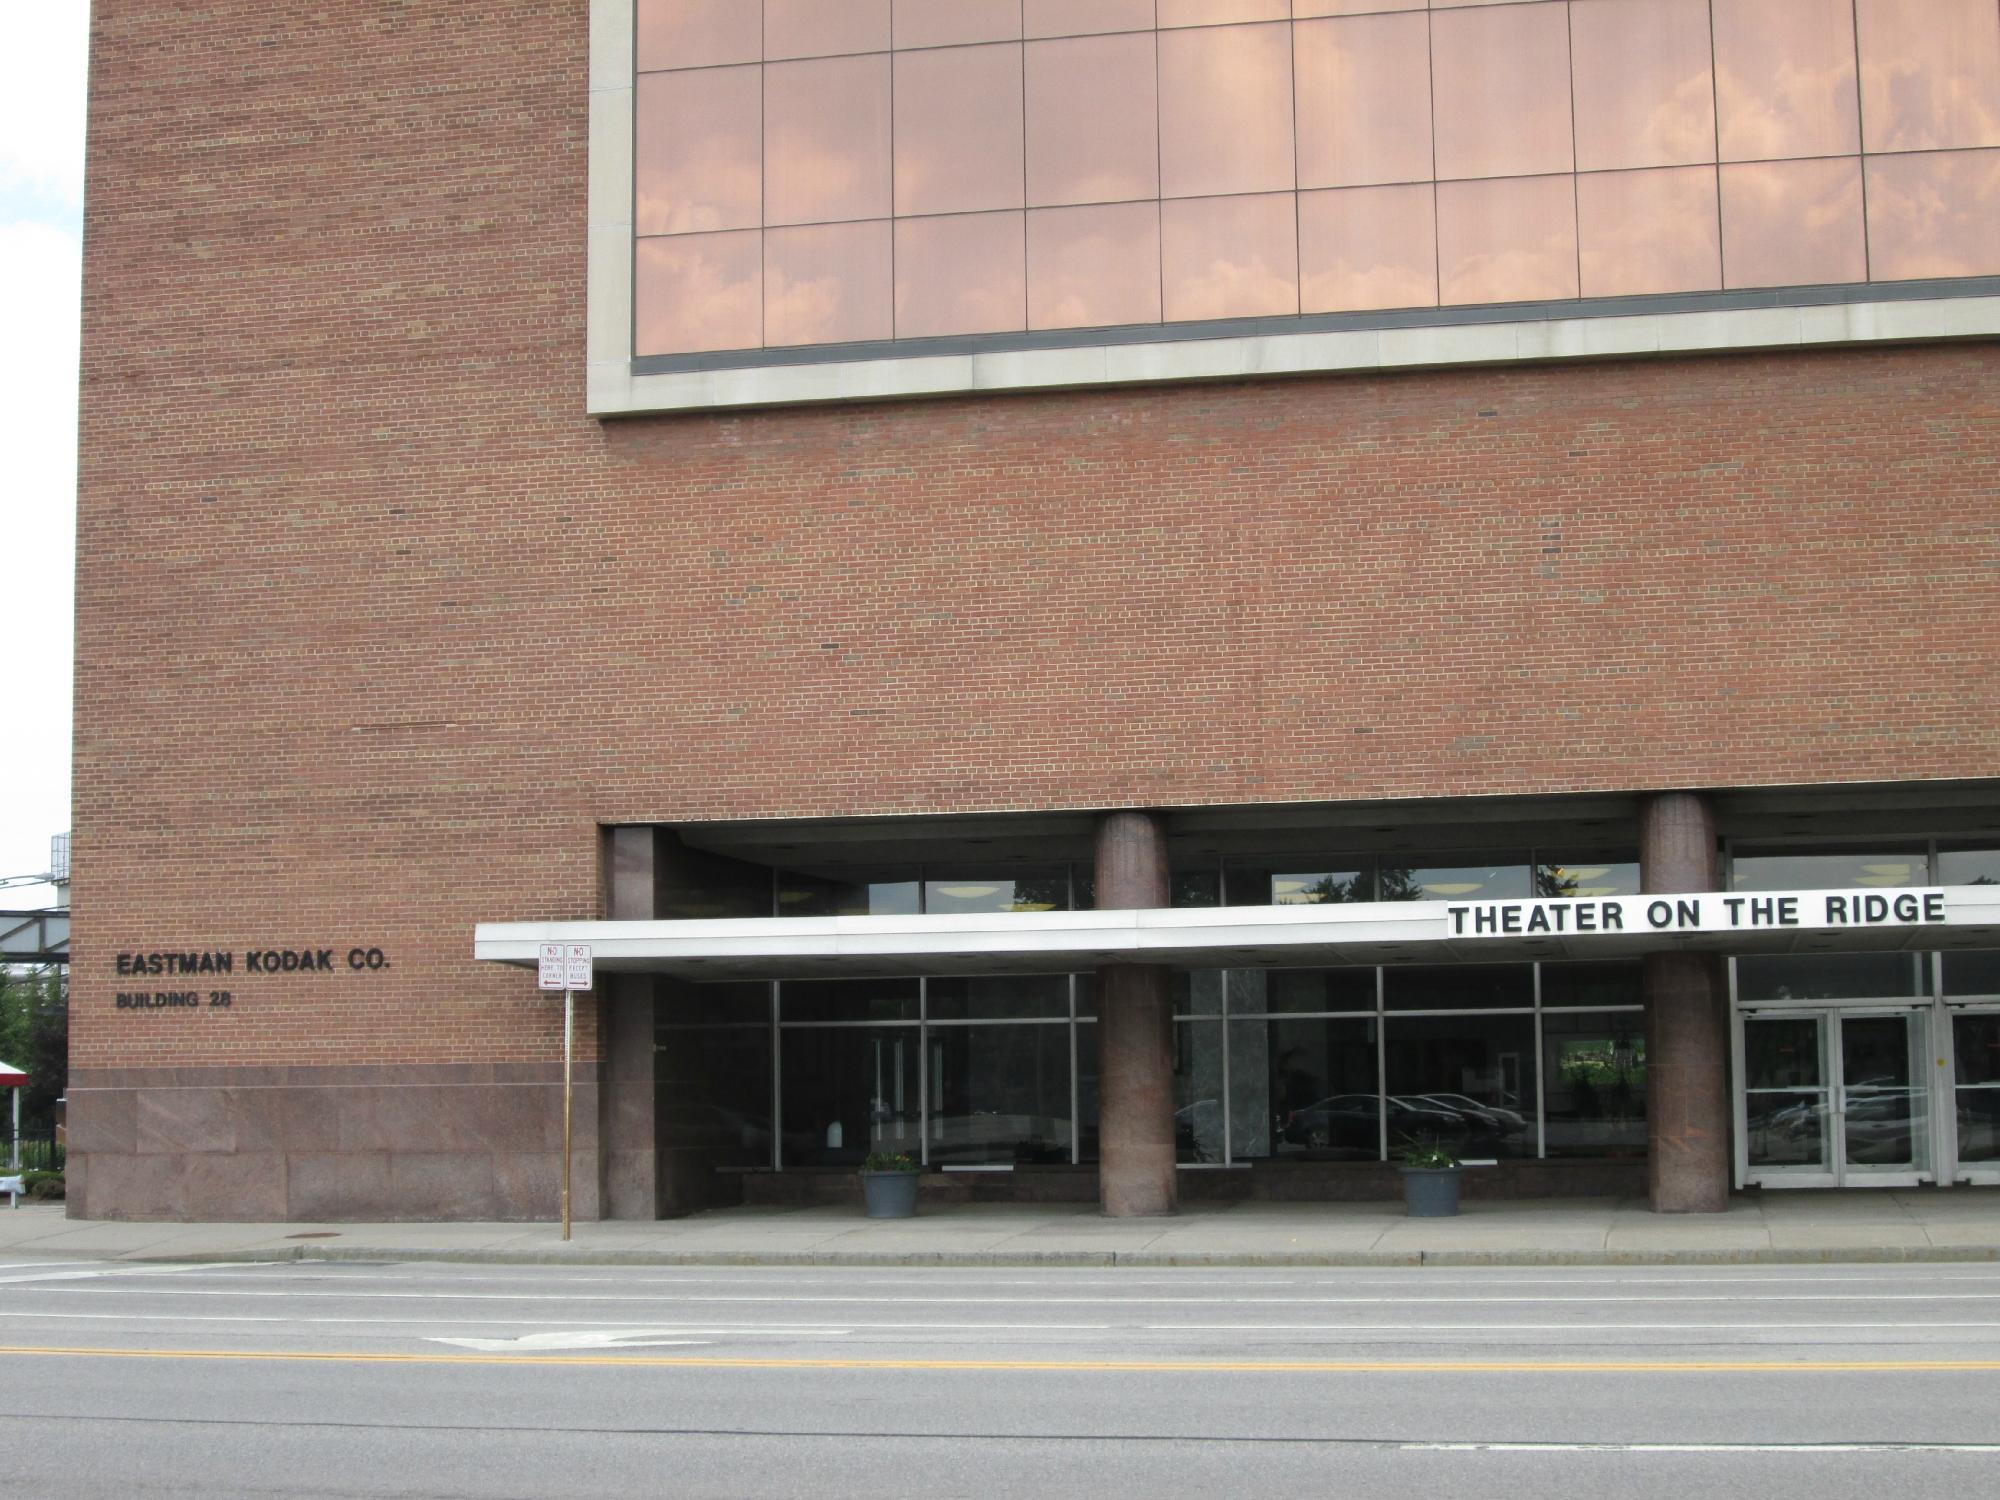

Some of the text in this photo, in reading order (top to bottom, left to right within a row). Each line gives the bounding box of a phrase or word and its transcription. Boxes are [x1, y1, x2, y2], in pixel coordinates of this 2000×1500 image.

[1448, 893, 1945, 933] THEATER ON THE RIDGE
[547, 946, 557, 956] NO
[573, 947, 584, 956] NO
[116, 948, 391, 974] EASTMAN KODAK CO.
[116, 991, 232, 1008] BUILDING 28
